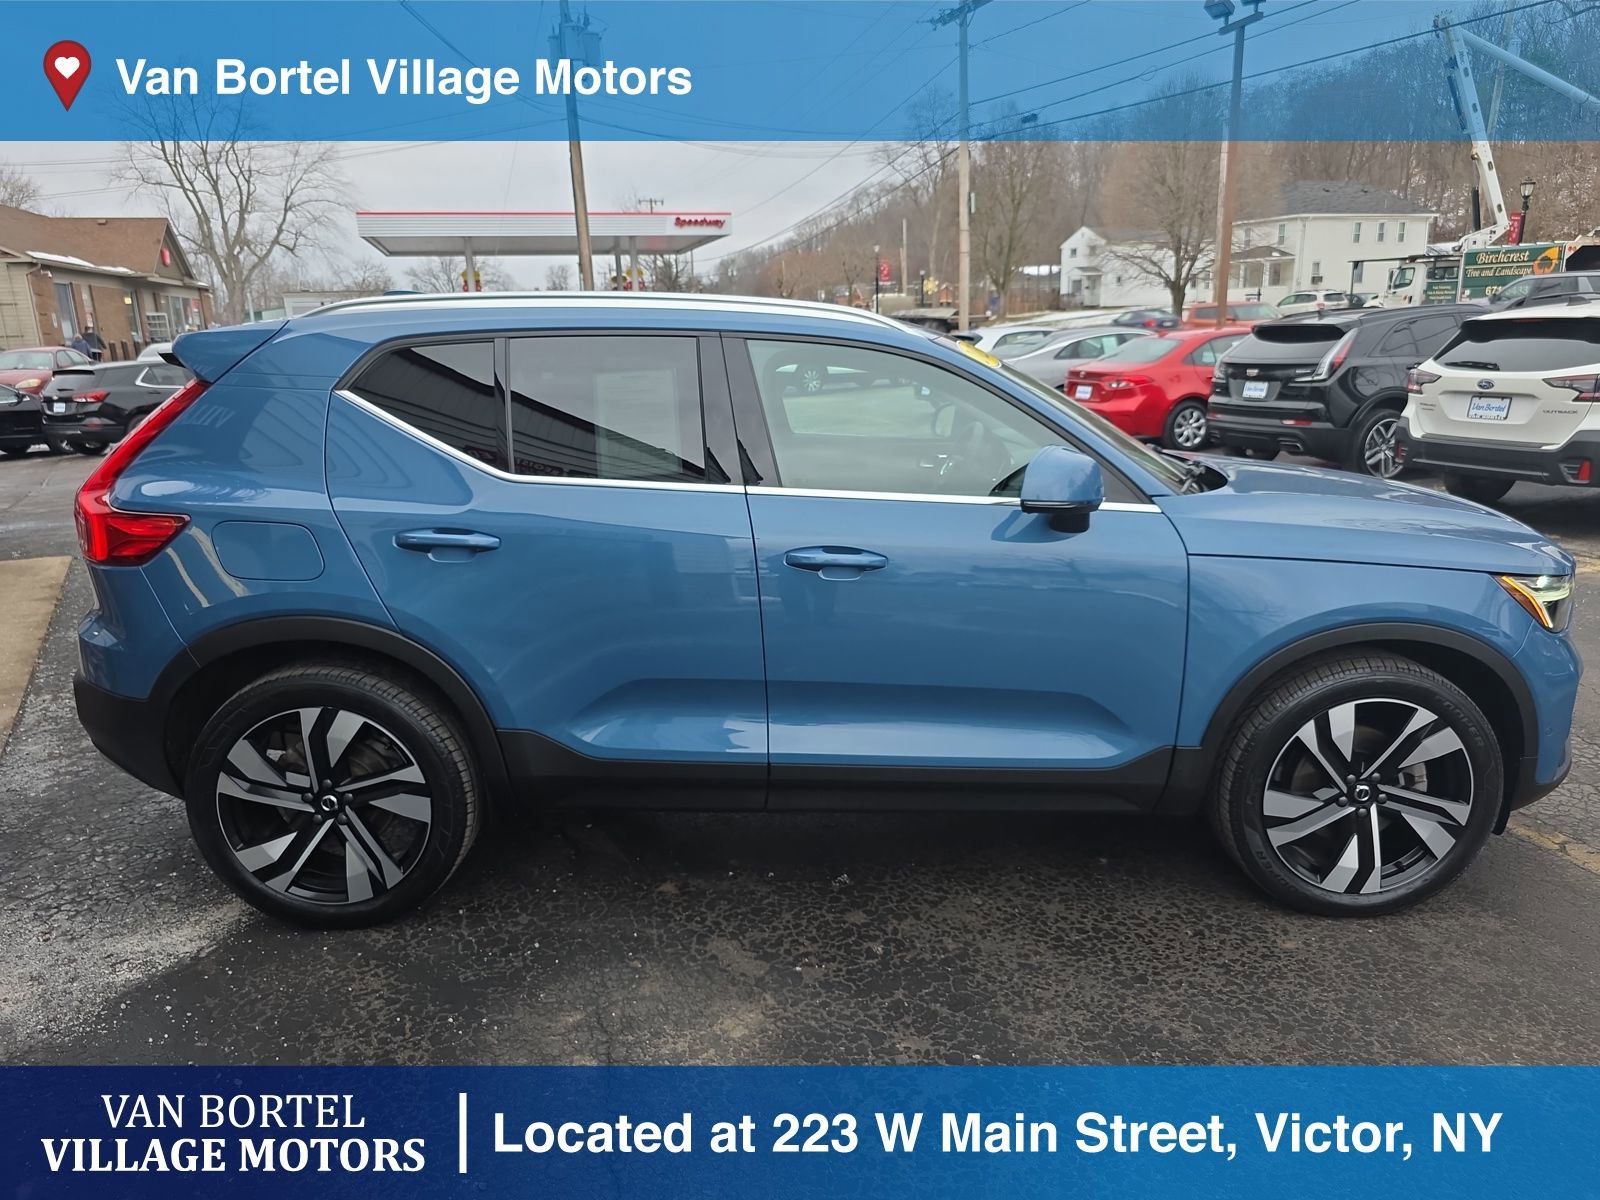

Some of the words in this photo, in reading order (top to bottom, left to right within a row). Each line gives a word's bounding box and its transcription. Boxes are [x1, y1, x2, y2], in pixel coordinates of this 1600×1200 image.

[674, 216, 726, 229] Speedway
[1475, 250, 1530, 265] Birchcrest
[1465, 268, 1481, 278] Tree
[1480, 267, 1493, 277] and
[1495, 266, 1533, 278] Landscape
[1472, 402, 1485, 412] Van
[1485, 403, 1507, 413] Bortel
